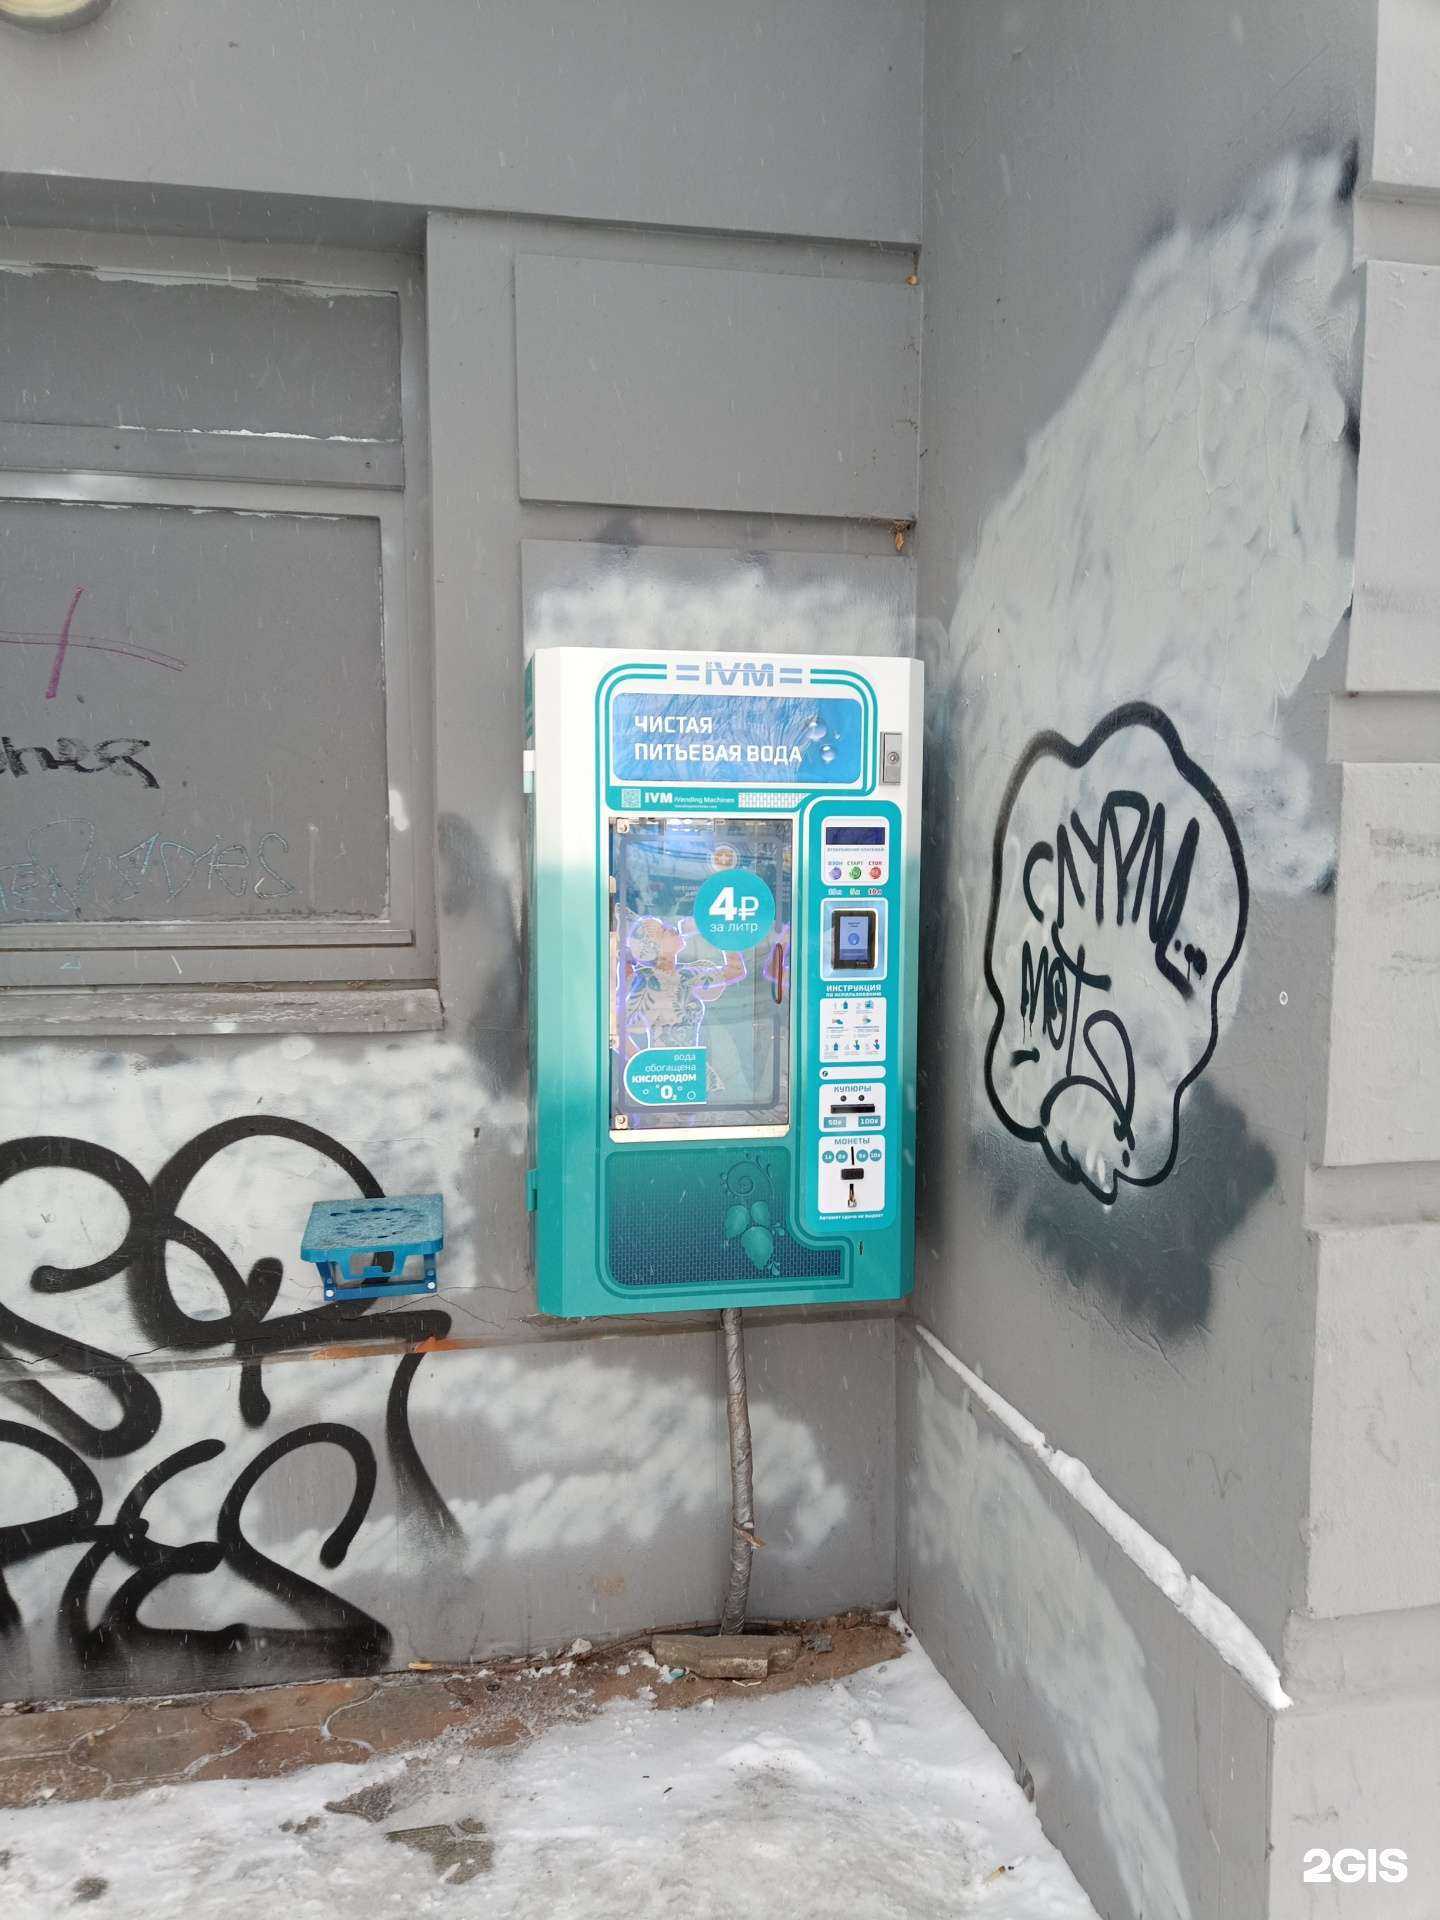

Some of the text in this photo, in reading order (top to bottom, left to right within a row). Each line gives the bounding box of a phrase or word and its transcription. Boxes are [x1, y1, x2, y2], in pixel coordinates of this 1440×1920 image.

[634, 715, 713, 733] ЧИСТАЯ
[634, 742, 802, 765] ПИТЬЕВАЯ ВОДА
[645, 792, 673, 804] IVM
[710, 922, 759, 934] за литр
[826, 984, 882, 992] ИНСТРУКЦИЯ
[673, 1054, 696, 1062] вода
[645, 1063, 696, 1073] обогащена
[631, 1073, 697, 1083] КИСЛОРОДОМ
[834, 1085, 872, 1093] КУПЮРЫ
